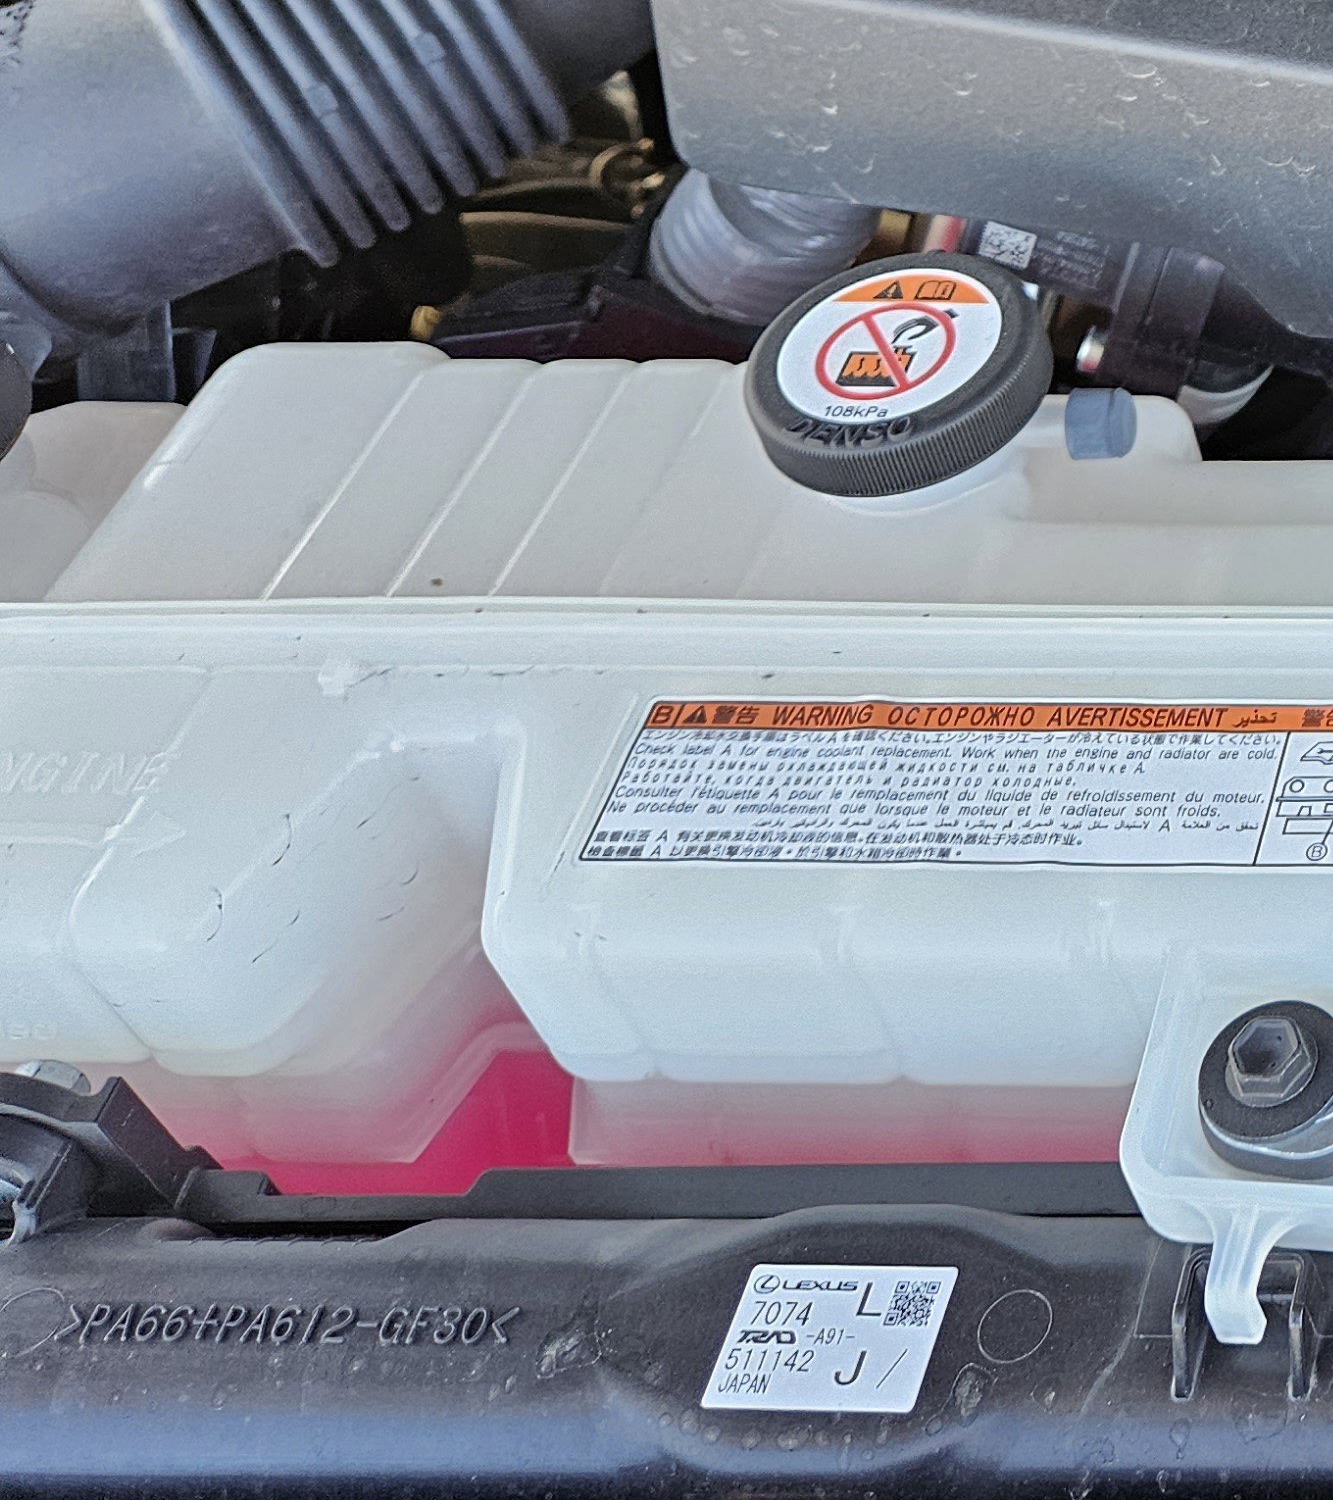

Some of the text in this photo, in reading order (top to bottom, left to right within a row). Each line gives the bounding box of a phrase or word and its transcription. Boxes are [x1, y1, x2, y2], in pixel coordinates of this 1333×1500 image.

[824, 404, 889, 418] 108kPa
[784, 416, 914, 447] DENSO
[652, 705, 674, 724] B
[772, 704, 874, 724] WARNING
[887, 706, 1034, 727] ОСТОРОЖНО
[1046, 707, 1228, 728] AVERTISSEMENT
[635, 743, 674, 755] Check
[683, 743, 715, 756] label
[721, 744, 732, 756] A
[739, 744, 757, 756] for
[766, 747, 810, 759] engine
[817, 744, 864, 757] coolant
[962, 746, 997, 758] Work
[1004, 746, 1038, 759] when
[1046, 748, 1067, 759] the
[1074, 748, 1118, 760] engine
[1125, 748, 1150, 759] and
[1159, 748, 1213, 759] radiator
[1218, 750, 1240, 760] are
[1247, 748, 1277, 760] cold.
[1017, 762, 1037, 774] на
[1046, 761, 1127, 774] табличке
[615, 785, 684, 798] Consulter
[767, 788, 779, 799] A
[788, 789, 821, 802] pour
[830, 787, 842, 800] le
[850, 788, 949, 802] remplacement
[957, 789, 977, 801] du
[984, 789, 1032, 803] liquide
[1040, 789, 1057, 801] de
[1066, 790, 1176, 802] refroidissement
[1185, 791, 1204, 802] du
[1212, 792, 1265, 804] moteur.
[607, 801, 1221, 818] Ne procéder au remplacement que lorsque le moteur et le radiateur sont froids.
[782, 1280, 859, 1291] LEXUS
[856, 1282, 882, 1317] L
[750, 1301, 814, 1326] 7074
[736, 1329, 797, 1344] TRD
[725, 1350, 867, 1386] 511142 J
[718, 1373, 772, 1394] JAPAN
